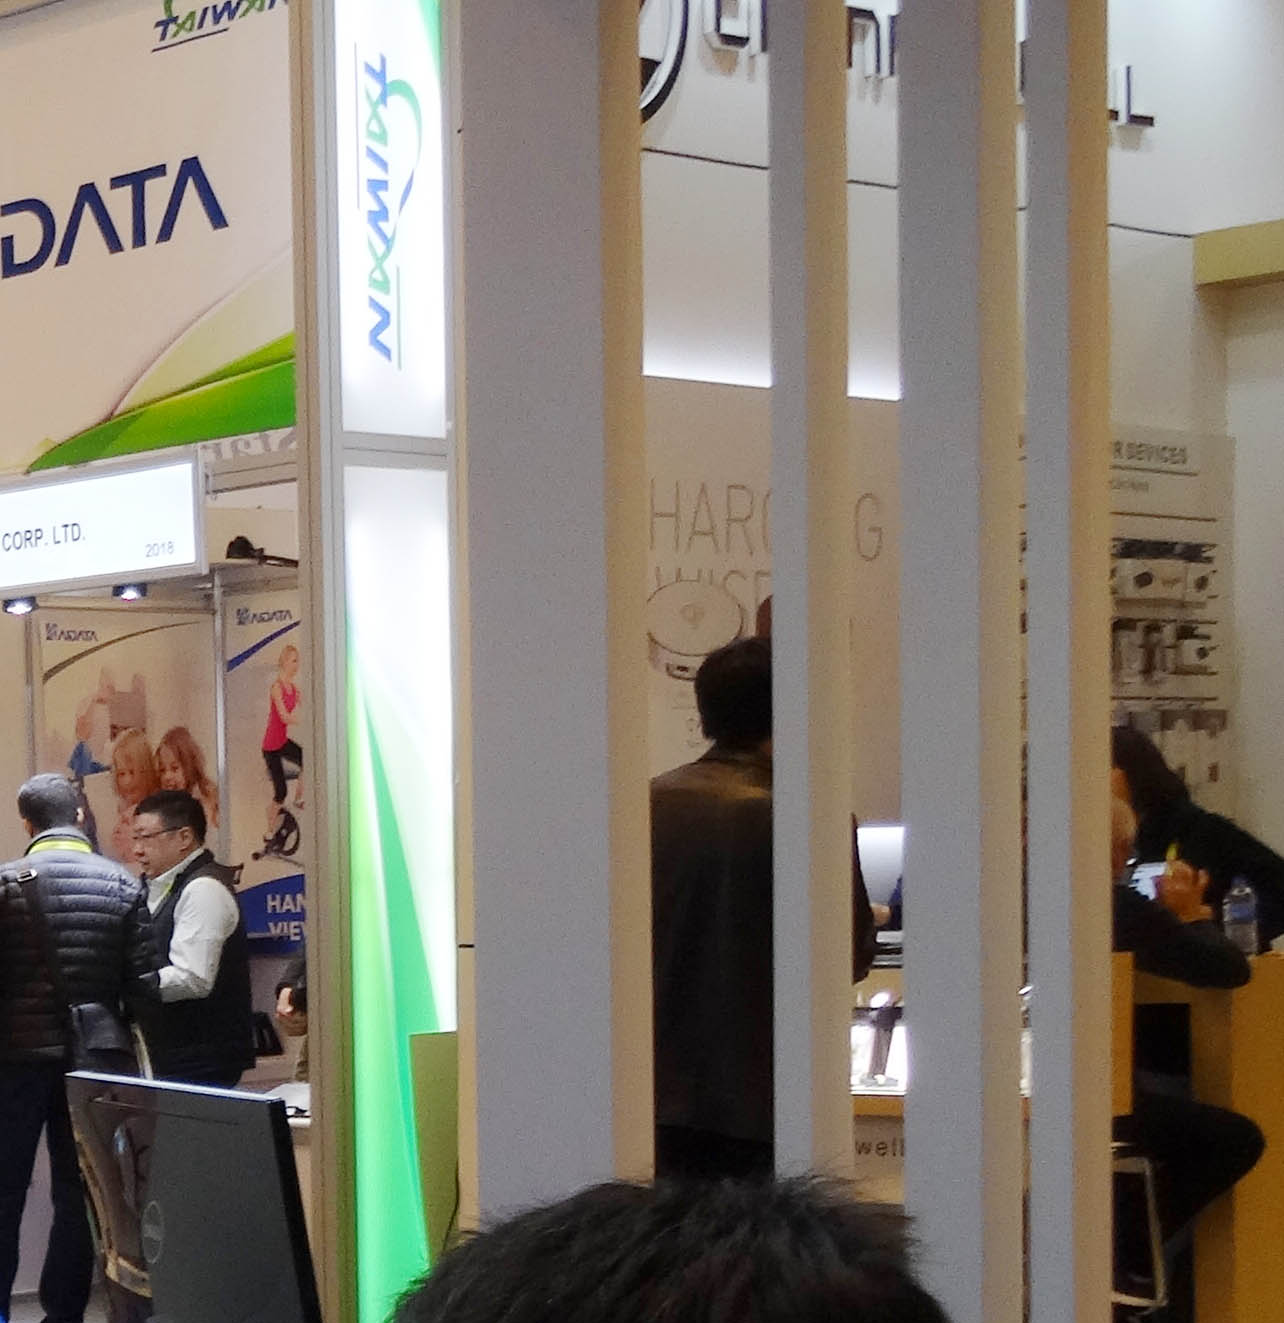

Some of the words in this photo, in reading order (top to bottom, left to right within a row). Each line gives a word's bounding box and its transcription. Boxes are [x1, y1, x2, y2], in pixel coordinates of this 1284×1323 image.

[363, 52, 392, 363] TAIWAN
[1, 527, 49, 553] CORP.
[52, 522, 86, 545] LTD.
[144, 540, 175, 559] 2018
[267, 920, 305, 941] VIE
